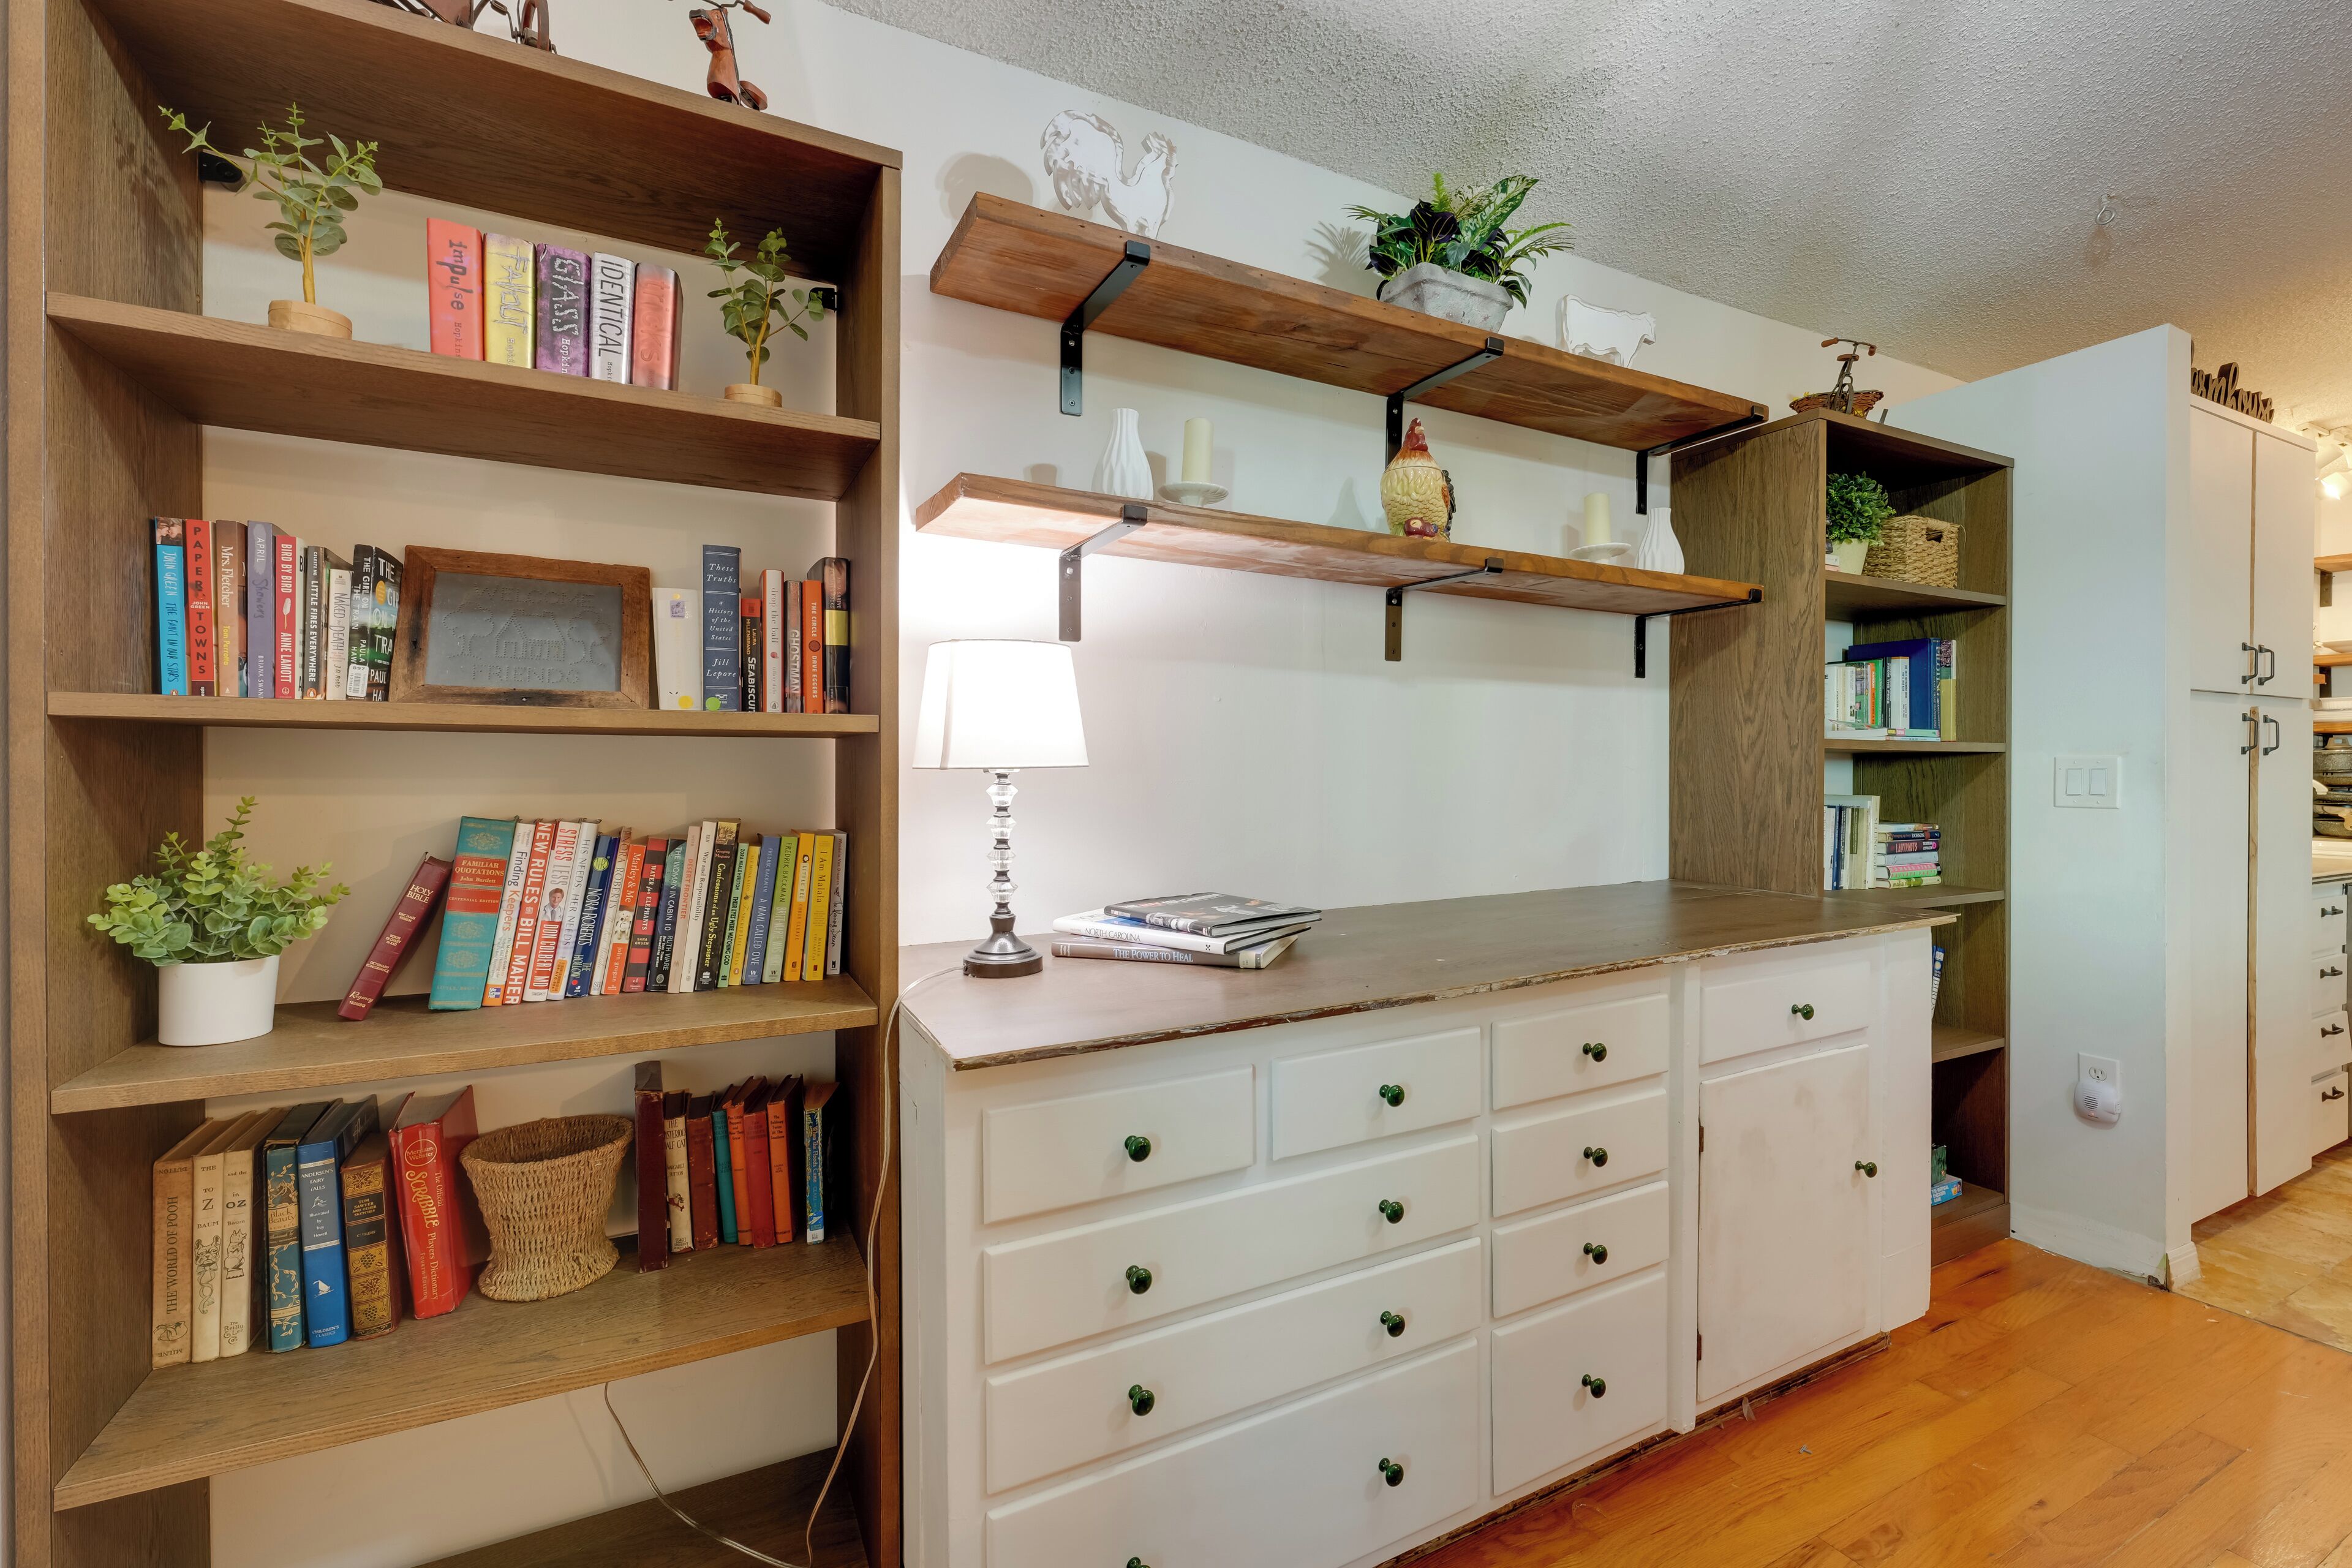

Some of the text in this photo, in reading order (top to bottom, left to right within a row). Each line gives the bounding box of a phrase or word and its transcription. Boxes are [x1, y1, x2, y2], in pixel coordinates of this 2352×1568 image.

[436, 239, 473, 310] Impulse
[598, 260, 624, 357] IDENTICAL
[641, 281, 670, 361] tricks
[193, 526, 203, 592] PAPER
[257, 537, 265, 562] APRIL
[221, 545, 234, 608] Mrs. Fletcher
[281, 544, 292, 593] BIRD BY BIRD
[378, 557, 394, 582] THE
[706, 575, 736, 583] Truths
[709, 563, 734, 571] These
[334, 592, 350, 619] NAKED
[361, 598, 369, 609] ON
[473, 582, 595, 608] WELCOME
[165, 603, 178, 615] THE
[352, 604, 360, 630] TRAIN
[167, 619, 179, 637] FAULT
[329, 625, 345, 651] DEATH
[167, 648, 178, 660] OUR
[195, 612, 208, 674] TOWNS
[281, 632, 292, 683] ANNE LAMOTT
[308, 631, 317, 682] EVERYWHERE
[712, 658, 729, 667] Jill
[167, 663, 179, 682] STARS
[471, 664, 580, 684] FRIENDS
[706, 669, 736, 679] Lepore
[551, 829, 577, 886] STRESS LESS
[1895, 842, 1918, 853] LADYPARTS
[454, 867, 505, 876] QUOTATIONS
[462, 860, 499, 869] FAMILIAR
[508, 851, 527, 887] Finding
[524, 822, 552, 904] NEW RULES
[627, 853, 641, 881] Marley
[670, 861, 680, 889] WOMAN
[780, 842, 792, 902] FREDRIK BACKMAN
[406, 891, 430, 903] BIBLE
[410, 884, 434, 897] HOLY
[625, 890, 635, 903] Me
[680, 859, 693, 919] DESERT FRONTIER
[692, 878, 705, 922] Responsibility
[502, 890, 520, 932] Keepers
[578, 888, 603, 946] NORA ROBERTS
[666, 900, 675, 921] CABIN
[756, 906, 767, 922] MAN
[725, 932, 734, 955] WATCHING
[753, 924, 764, 949] CALLED
[1085, 927, 1141, 942] NORTH CAROLINA
[505, 918, 534, 1005] BILL MAHER
[571, 954, 584, 979] HOLLOW
[582, 962, 592, 971] THE
[663, 951, 671, 971] WARE
[750, 951, 761, 966] OVE
[349, 991, 374, 1003] Regency
[1931, 978, 1940, 1011] BIRDS
[409, 1152, 434, 1161] Webster
[158, 1166, 187, 1175] DUTTON
[301, 1168, 334, 1178] ANDERSEN'S
[202, 1197, 214, 1211] Z
[225, 1199, 246, 1209] OZ
[405, 1170, 440, 1229] SCRABBLE
[197, 1221, 219, 1229] BAUM
[166, 1196, 178, 1314] THE WORLD OF POOH
[426, 1232, 439, 1300] Players Dictionary
[157, 1349, 183, 1357] MILNE
